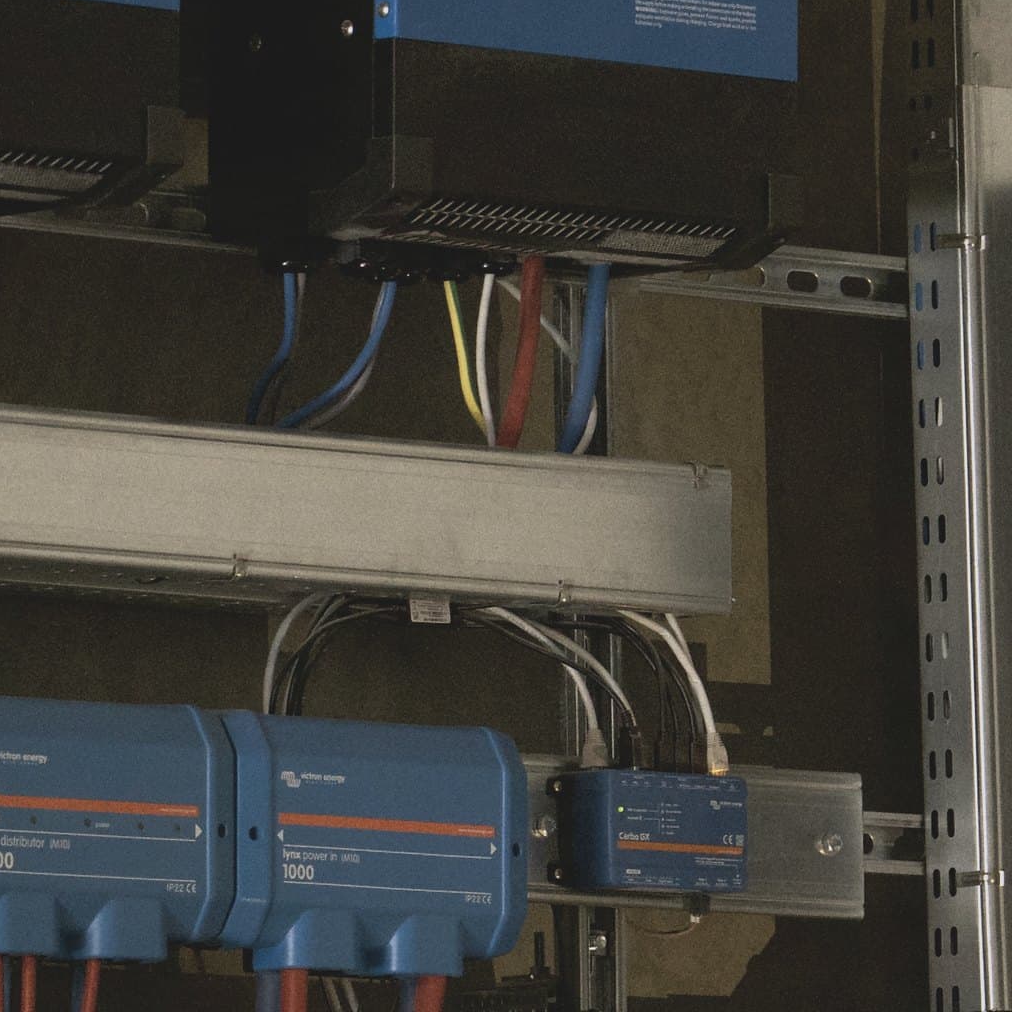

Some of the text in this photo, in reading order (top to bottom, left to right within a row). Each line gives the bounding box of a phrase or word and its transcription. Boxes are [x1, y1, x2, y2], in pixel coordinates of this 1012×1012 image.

[22, 754, 48, 765] energy
[300, 772, 346, 785] victron energy
[0, 834, 45, 849] distributor
[283, 848, 301, 861] lynx
[302, 851, 328, 862] power
[282, 863, 314, 880] 1000
